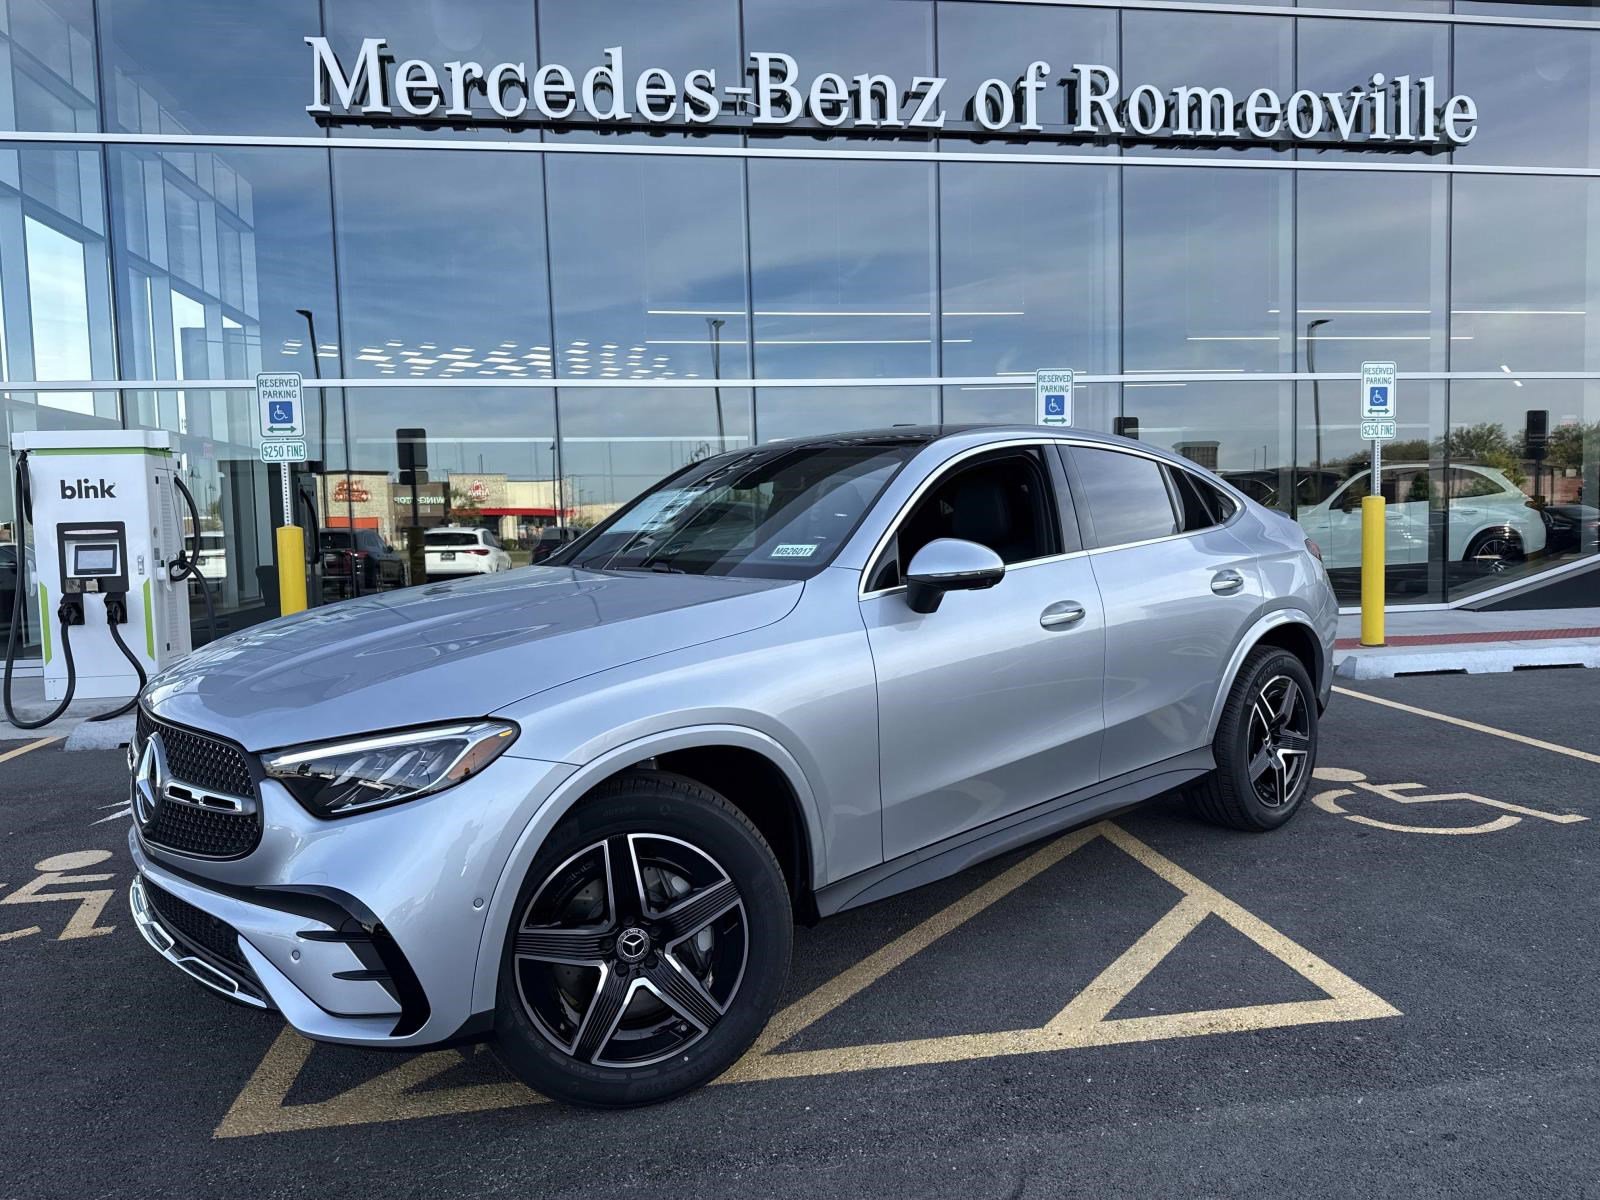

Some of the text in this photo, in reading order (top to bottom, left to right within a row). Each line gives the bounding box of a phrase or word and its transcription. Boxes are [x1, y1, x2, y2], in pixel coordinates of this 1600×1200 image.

[304, 36, 1478, 145] Mercedes-Benz of Romeoville
[259, 378, 298, 388] RESERVED
[1038, 374, 1071, 383] RESERVED
[1041, 385, 1069, 393] PARKING
[262, 390, 297, 399] PARKING
[1364, 425, 1393, 436] $250 FINE
[263, 444, 304, 458] $250 FINE
[60, 478, 117, 499] blink
